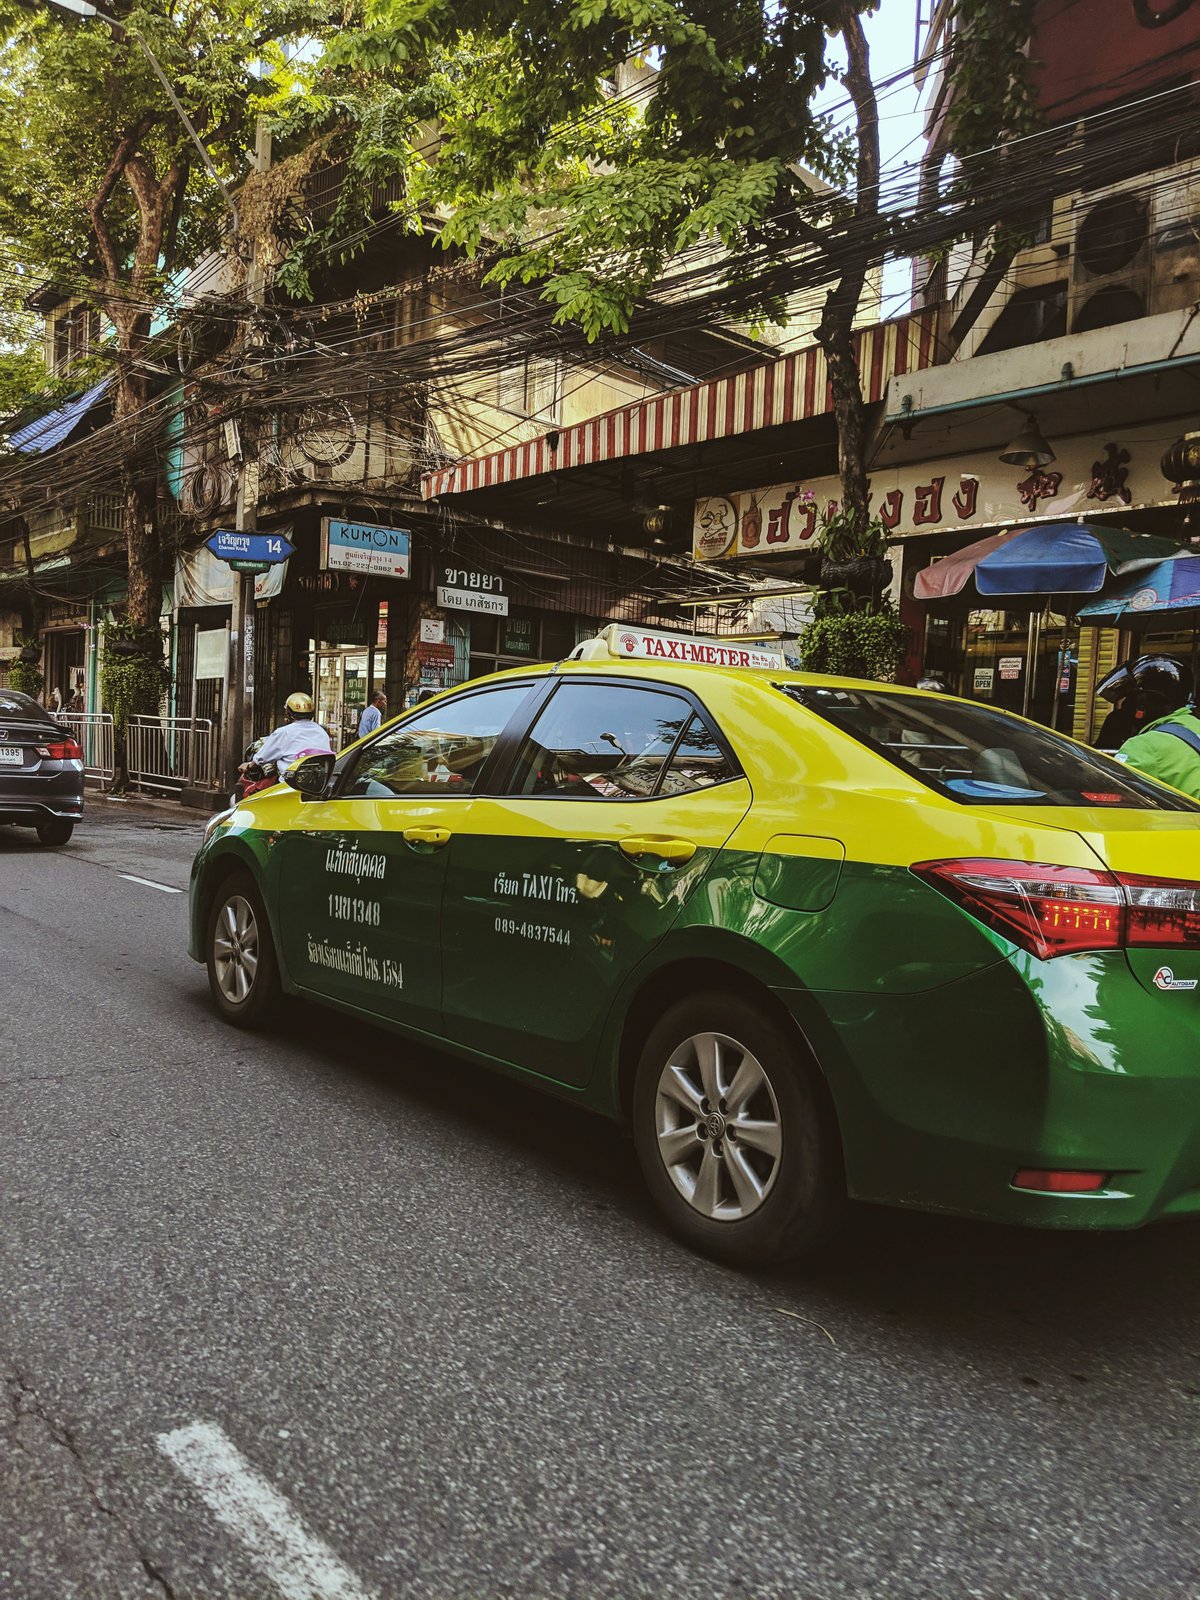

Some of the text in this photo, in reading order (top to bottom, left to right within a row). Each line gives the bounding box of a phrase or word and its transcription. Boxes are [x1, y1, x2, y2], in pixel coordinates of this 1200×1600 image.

[766, 476, 979, 545] ฮั่วเงฮง
[218, 533, 282, 554] เจริญกรุง 14
[341, 527, 398, 546] KUMON
[445, 568, 503, 592] ขายยา
[442, 589, 504, 611] โดย เภสัชกร
[642, 637, 750, 667] TAXI-METER
[975, 680, 991, 688] OPEN
[1, 748, 20, 757] 1395
[325, 839, 387, 885] แท็กซี่บุคคล
[493, 872, 579, 904] เรียก TAXI โทร.
[494, 917, 571, 946] 089-4837544
[382, 959, 404, 990] 1584
